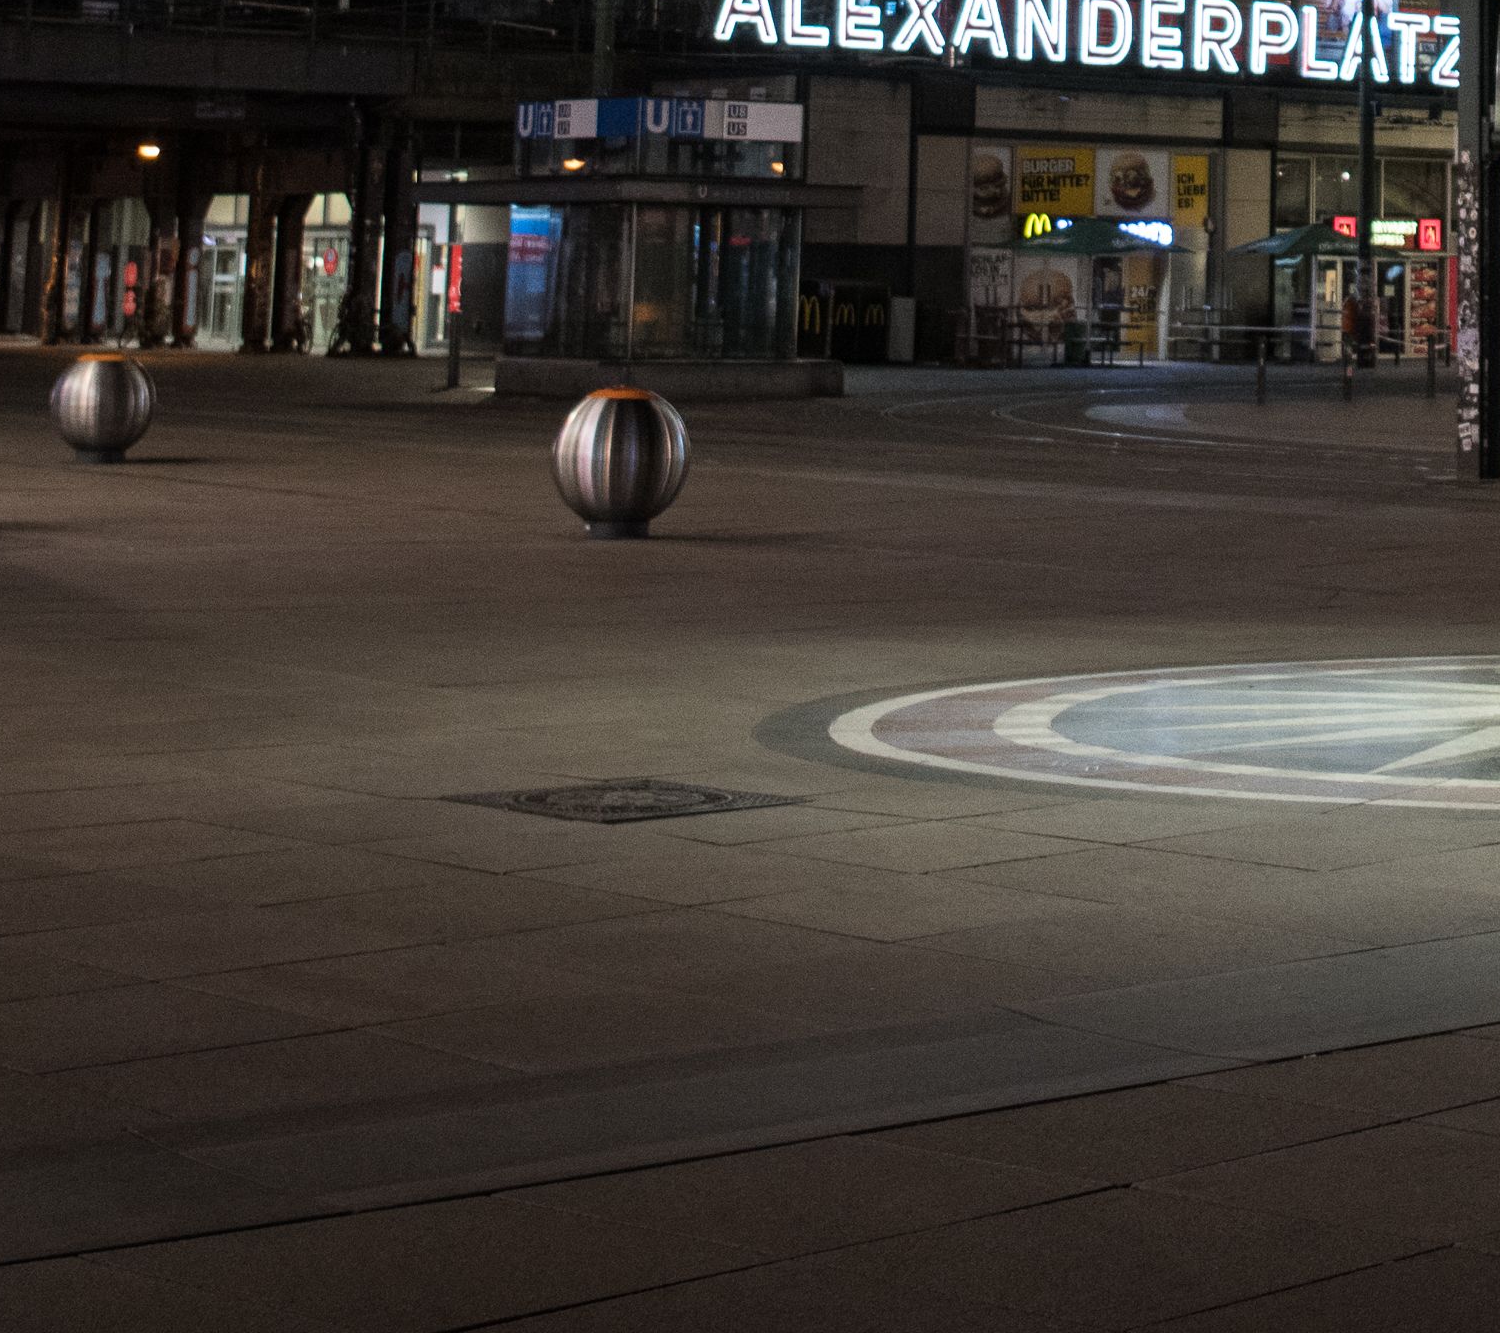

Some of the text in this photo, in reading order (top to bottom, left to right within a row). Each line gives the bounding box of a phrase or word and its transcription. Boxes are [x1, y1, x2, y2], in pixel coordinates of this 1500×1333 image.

[646, 98, 671, 134] U
[1021, 158, 1075, 174] BURGER
[1177, 173, 1195, 185] ICH
[1021, 189, 1061, 203] BITTE!
[1177, 184, 1206, 196] LIEBE
[1177, 197, 1194, 209] ES!
